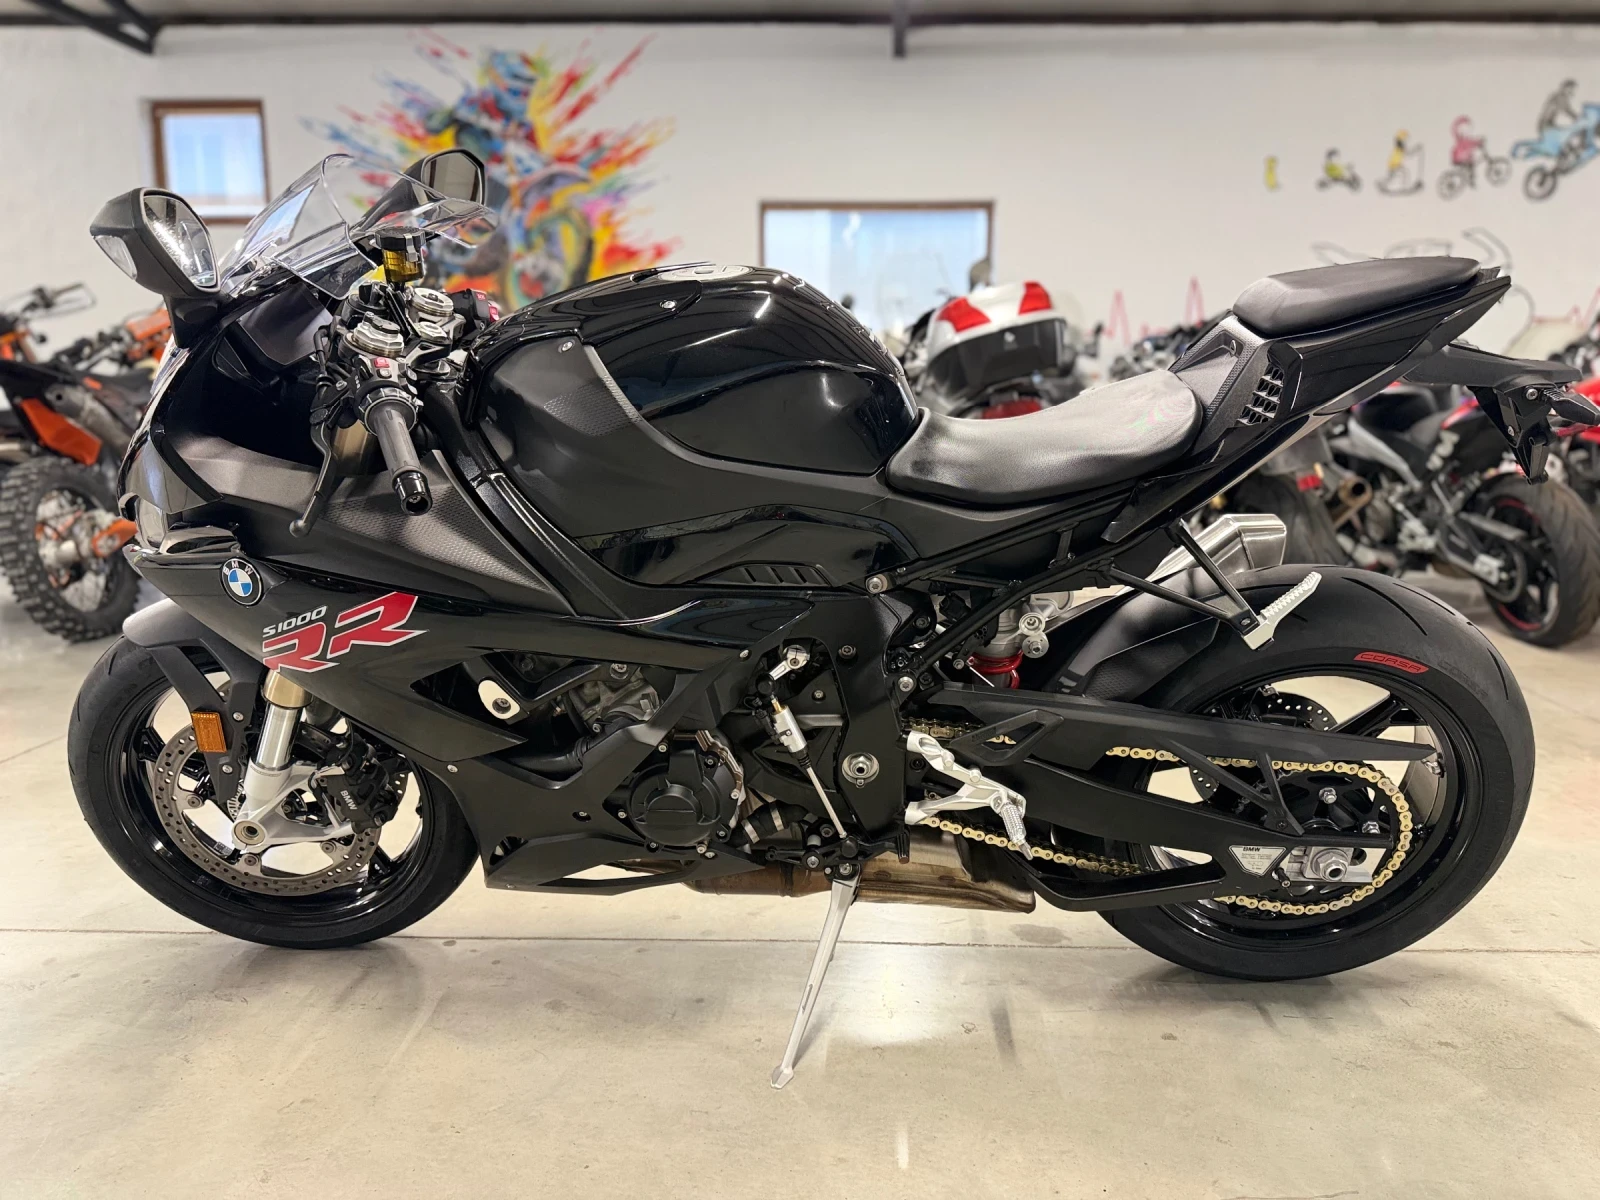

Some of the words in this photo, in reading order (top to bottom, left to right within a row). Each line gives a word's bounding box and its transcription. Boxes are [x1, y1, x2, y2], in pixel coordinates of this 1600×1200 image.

[222, 560, 254, 576] BMW
[262, 605, 328, 638] S1000
[262, 591, 430, 673] RR
[1360, 653, 1422, 672] CORSA
[340, 790, 358, 810] BMW
